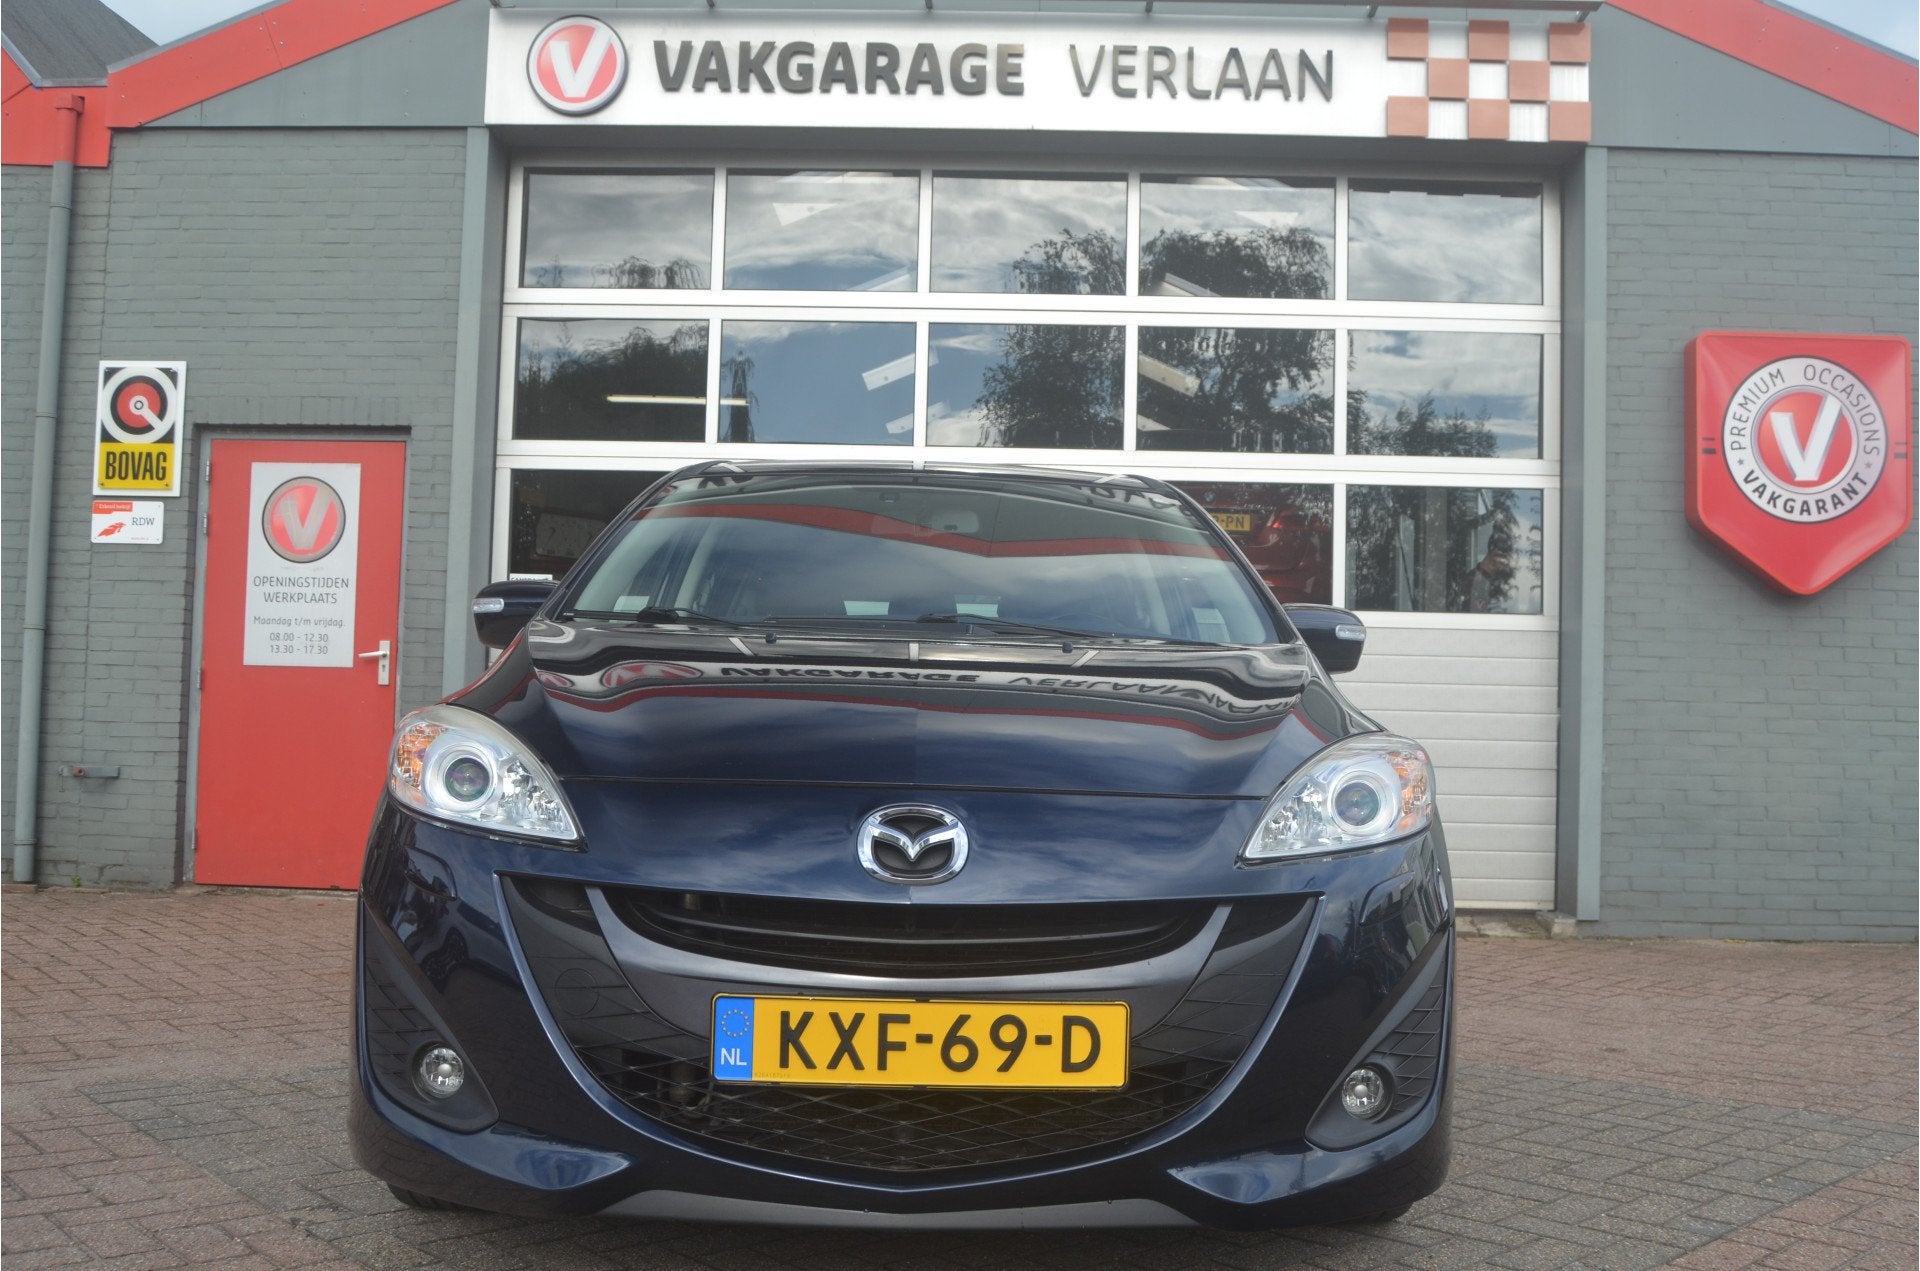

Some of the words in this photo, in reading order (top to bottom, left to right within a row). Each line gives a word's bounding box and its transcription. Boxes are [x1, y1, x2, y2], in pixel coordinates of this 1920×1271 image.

[653, 40, 1024, 96] VAKGARAGE
[1069, 44, 1333, 102] VERLAAN
[1731, 368, 1786, 451] PREMIUM
[1803, 364, 1880, 456] OCCASIONS
[105, 451, 167, 481] BOVAG
[1743, 469, 1867, 516] VAKGARANT
[132, 517, 155, 526] RDW
[253, 575, 349, 589] OPENINGSTIJDEN
[263, 592, 338, 604] WERKPLAATS
[253, 616, 292, 627] Maandag
[294, 616, 311, 626] t/m
[779, 1010, 1101, 1073] KXF-69-D
[720, 1047, 747, 1066] NL
